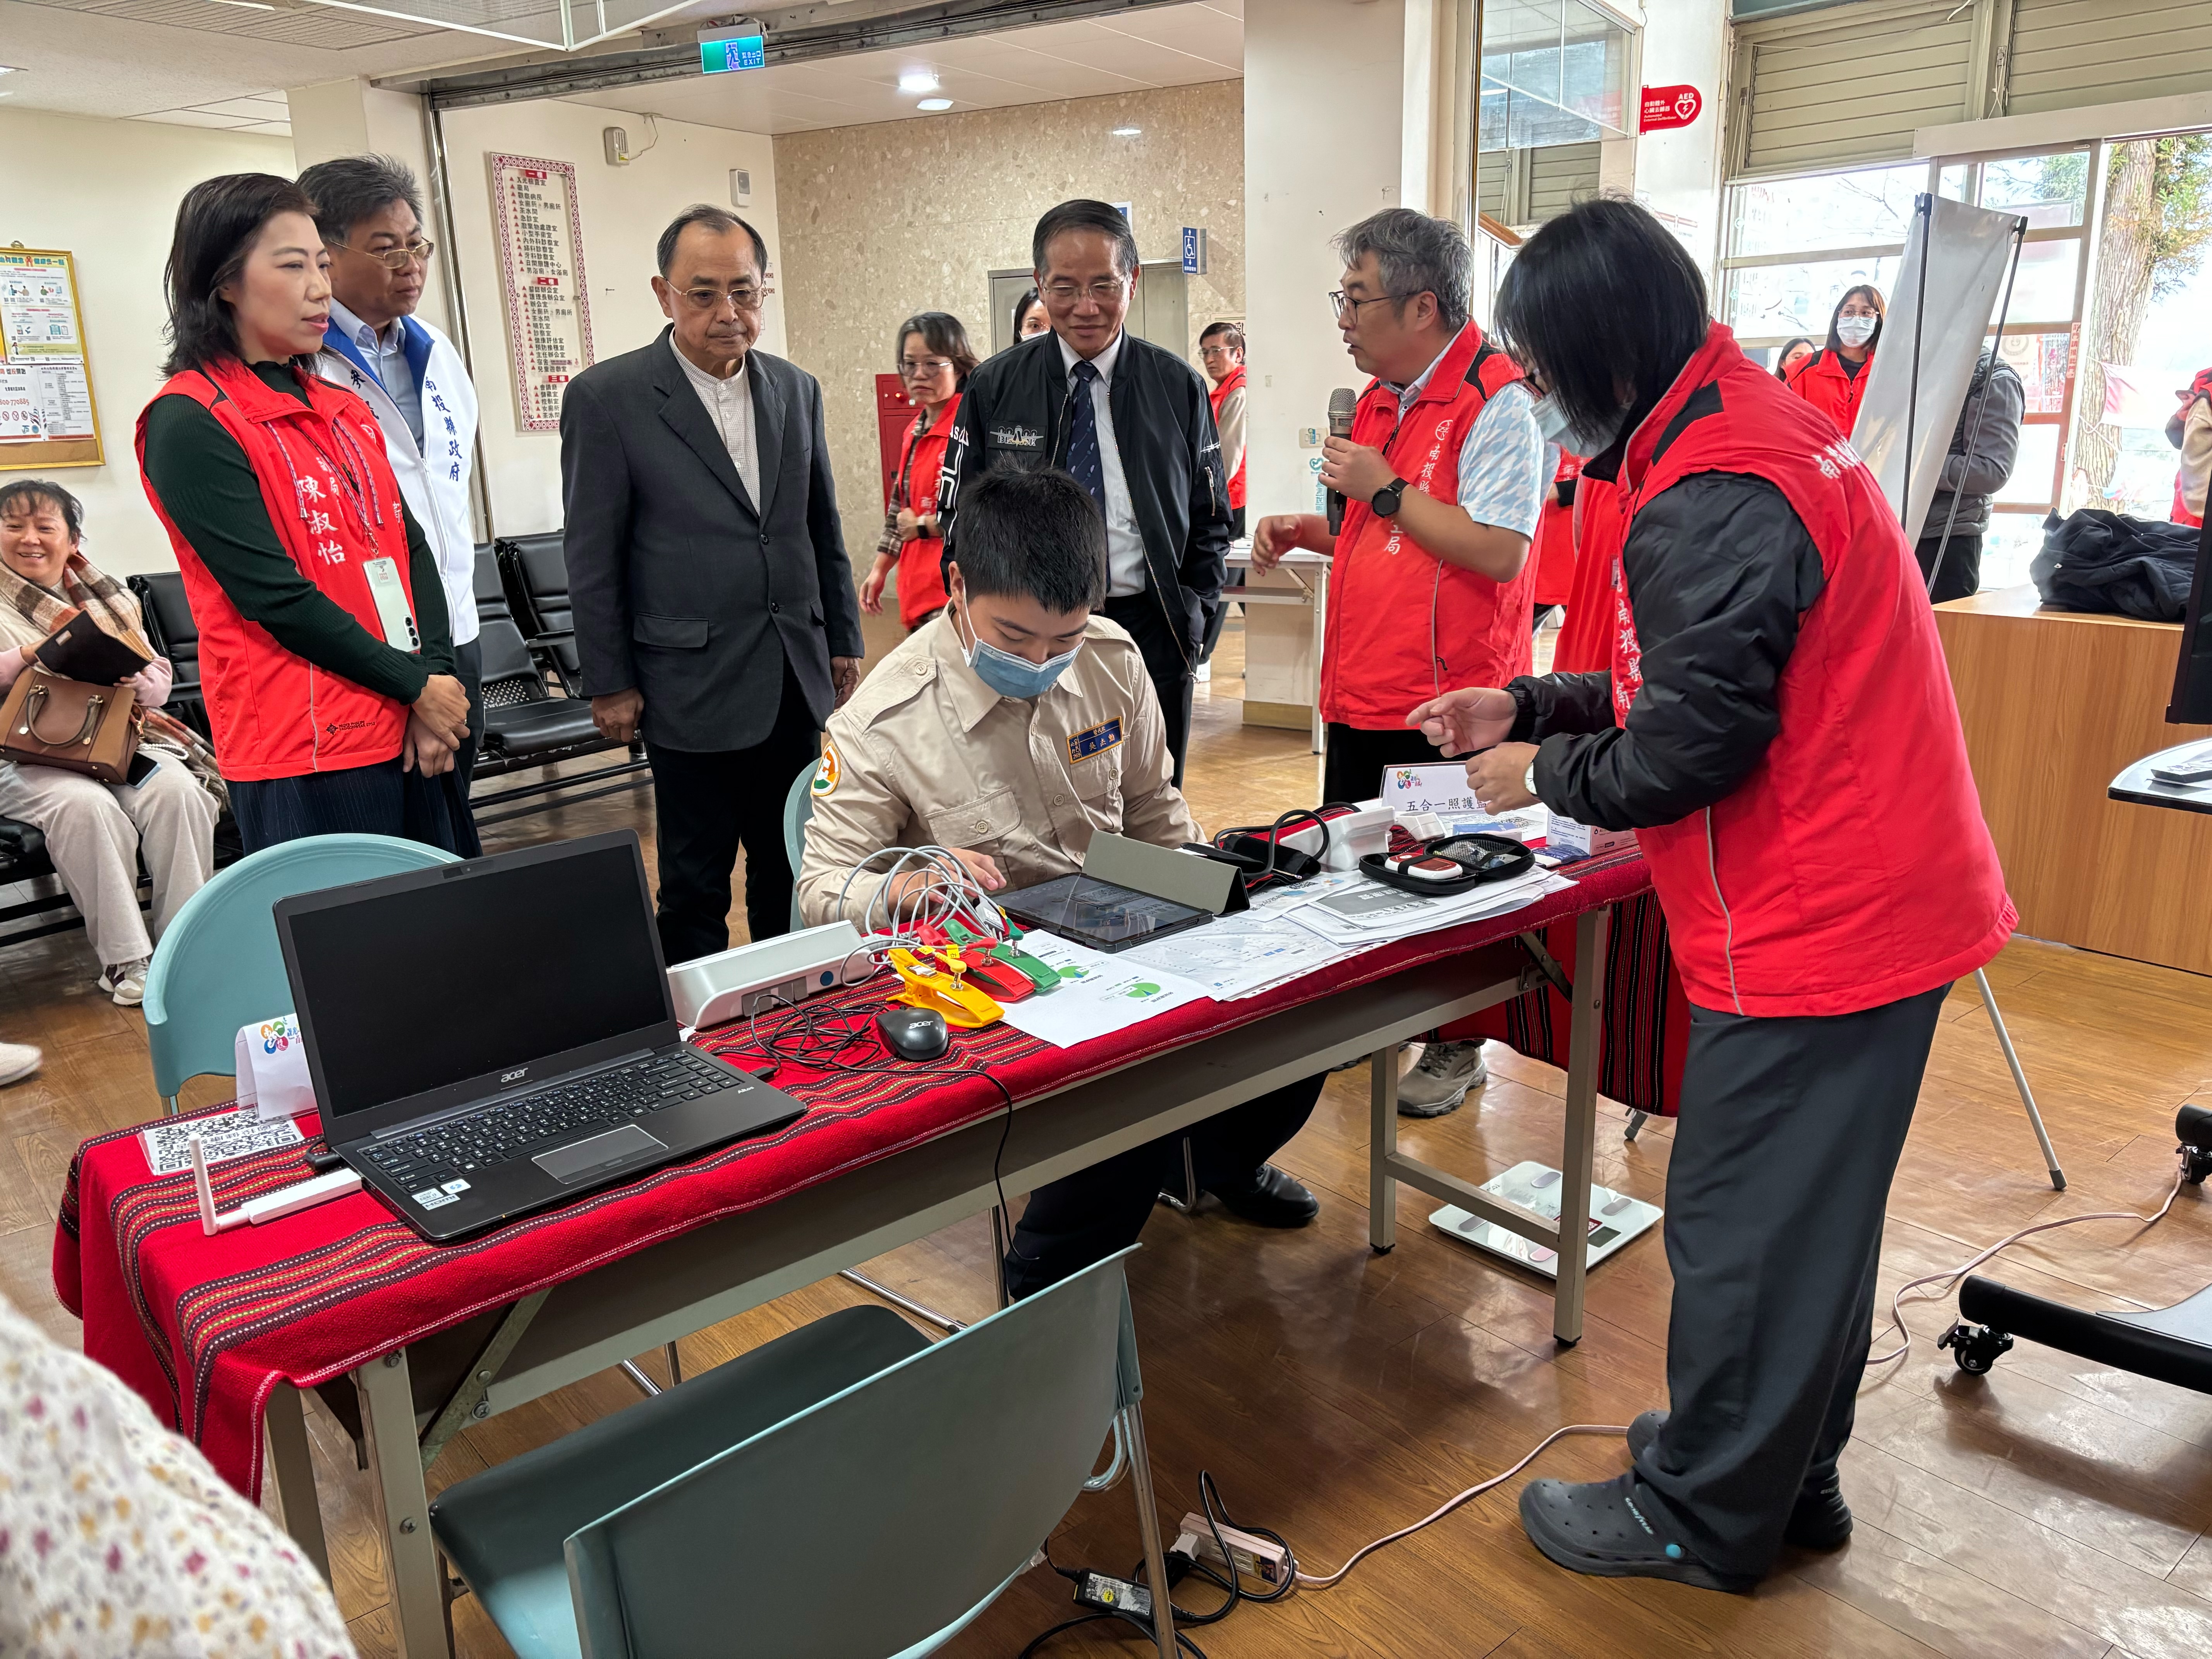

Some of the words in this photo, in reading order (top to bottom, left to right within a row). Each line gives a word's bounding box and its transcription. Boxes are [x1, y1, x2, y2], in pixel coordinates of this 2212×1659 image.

[425, 376, 462, 482] 南投縣政府
[298, 475, 346, 565] 陳淑怡
[908, 1020, 934, 1030] acer
[501, 1067, 529, 1083] acer
[425, 1195, 456, 1208] HDMI
